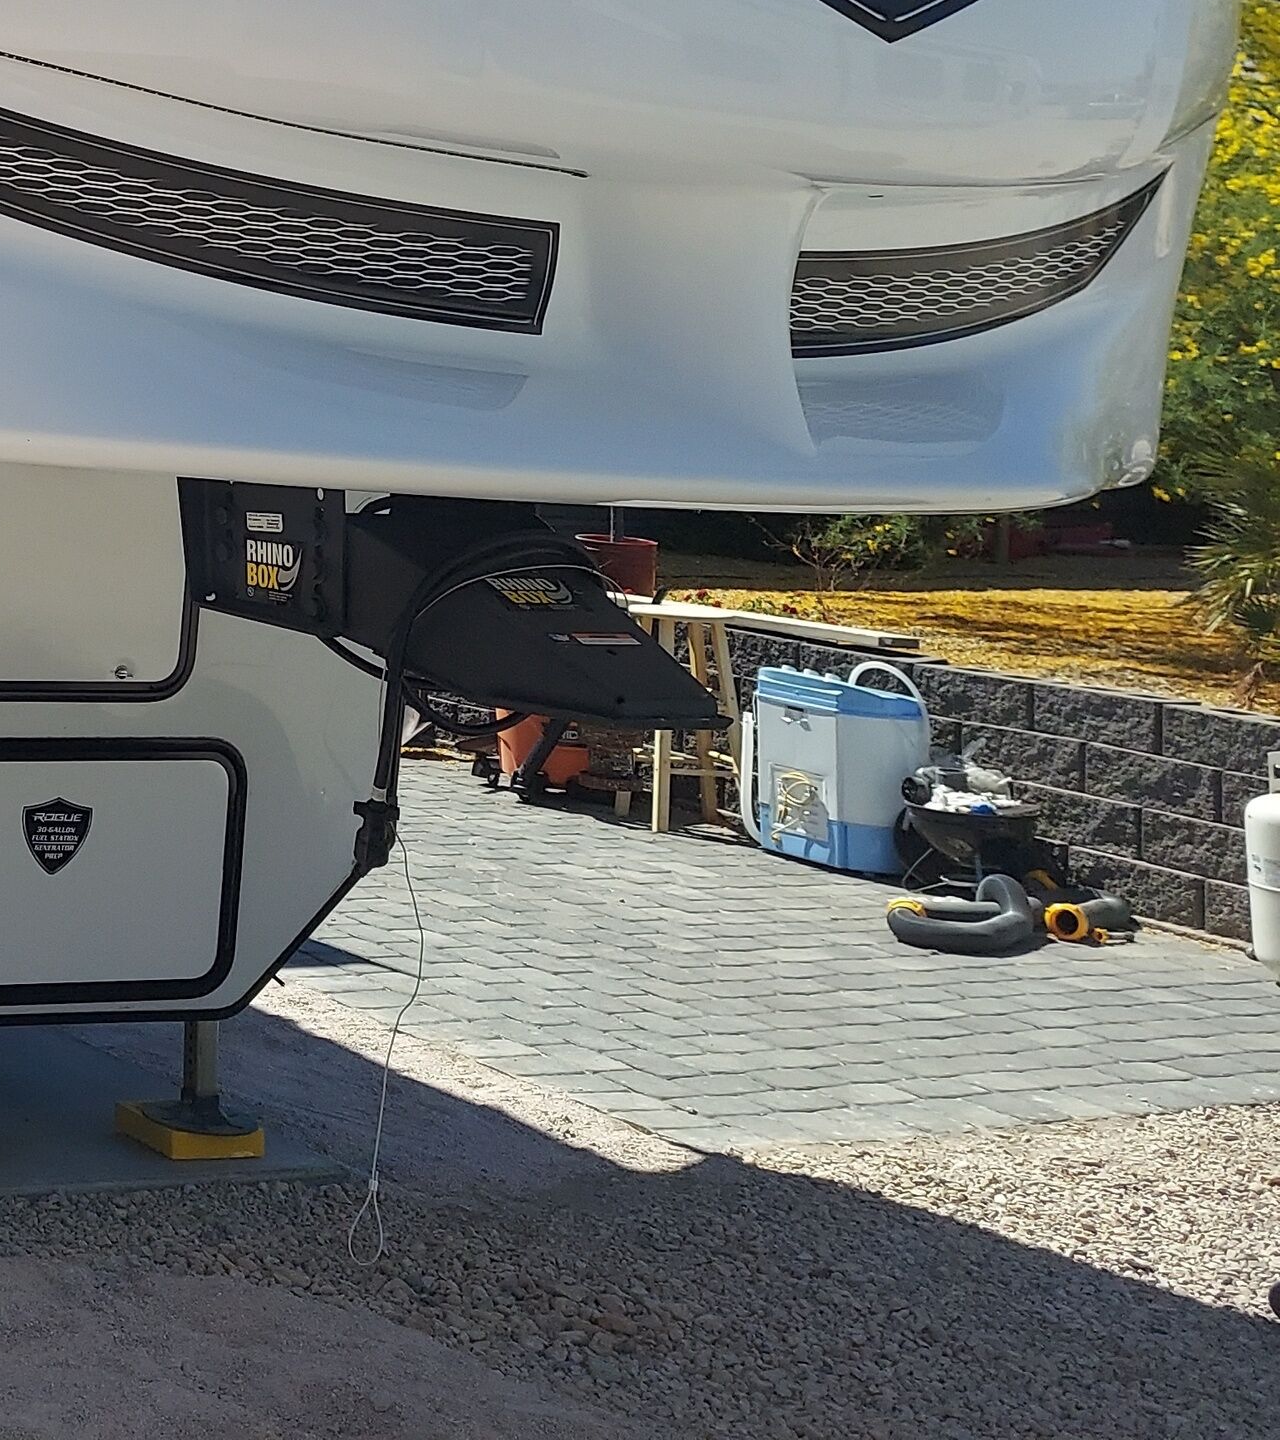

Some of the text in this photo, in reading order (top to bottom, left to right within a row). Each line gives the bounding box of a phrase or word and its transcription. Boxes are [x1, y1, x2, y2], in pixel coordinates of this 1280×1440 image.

[246, 539, 294, 568] RHINO
[246, 562, 279, 590] BOX
[484, 577, 558, 591] RHINO
[500, 590, 557, 604] BOX
[32, 812, 83, 822] ROGUE
